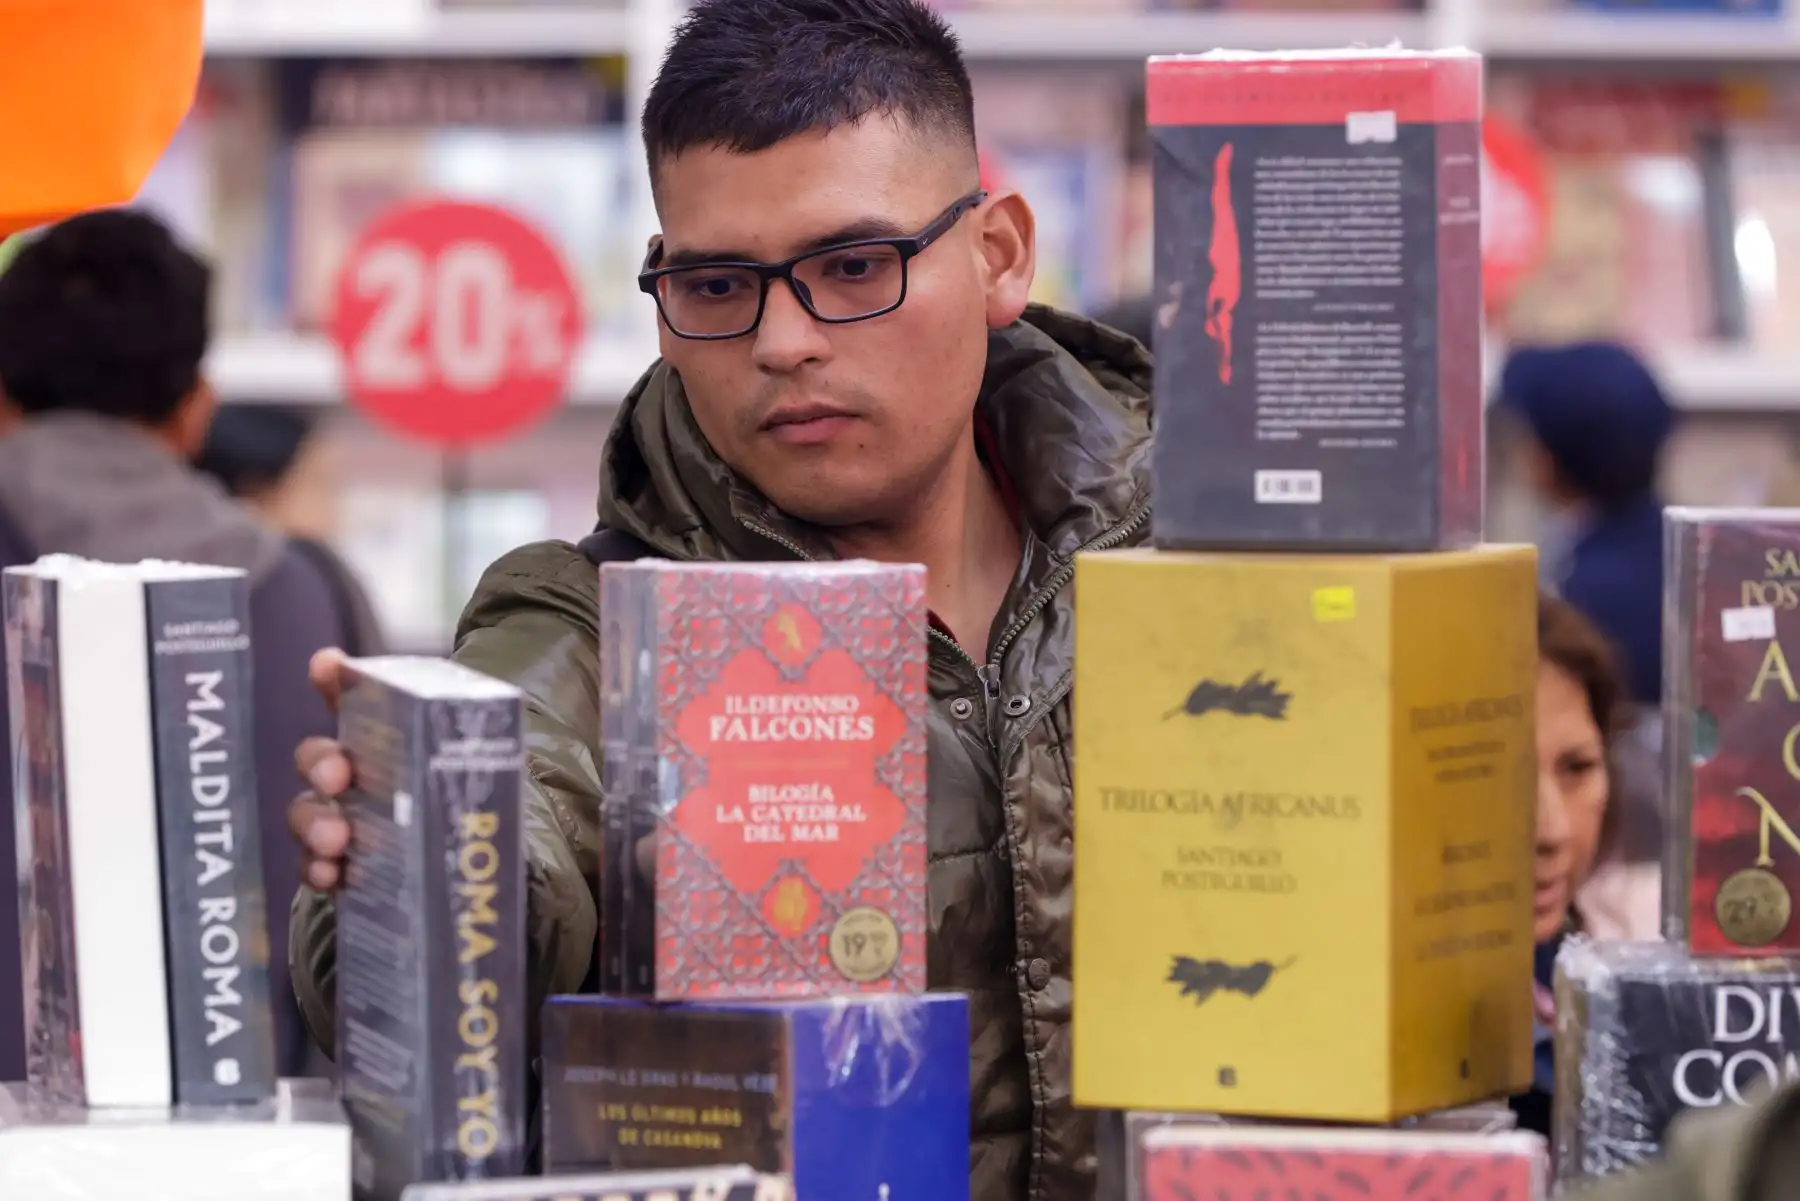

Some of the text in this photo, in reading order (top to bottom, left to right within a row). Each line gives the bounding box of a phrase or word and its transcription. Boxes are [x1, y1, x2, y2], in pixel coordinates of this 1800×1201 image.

[355, 236, 565, 392] 20%
[709, 715, 876, 742] FALCONES
[724, 695, 861, 714] ILDEFONSO
[715, 803, 868, 824] LA CATEDRAL
[747, 781, 835, 804] BILOGÍA
[185, 670, 243, 1046] MALDITA ROMA
[743, 824, 840, 843] DEL MAR
[457, 812, 499, 964] ROMA
[457, 977, 499, 1080] SOY
[457, 1088, 499, 1159] YO
